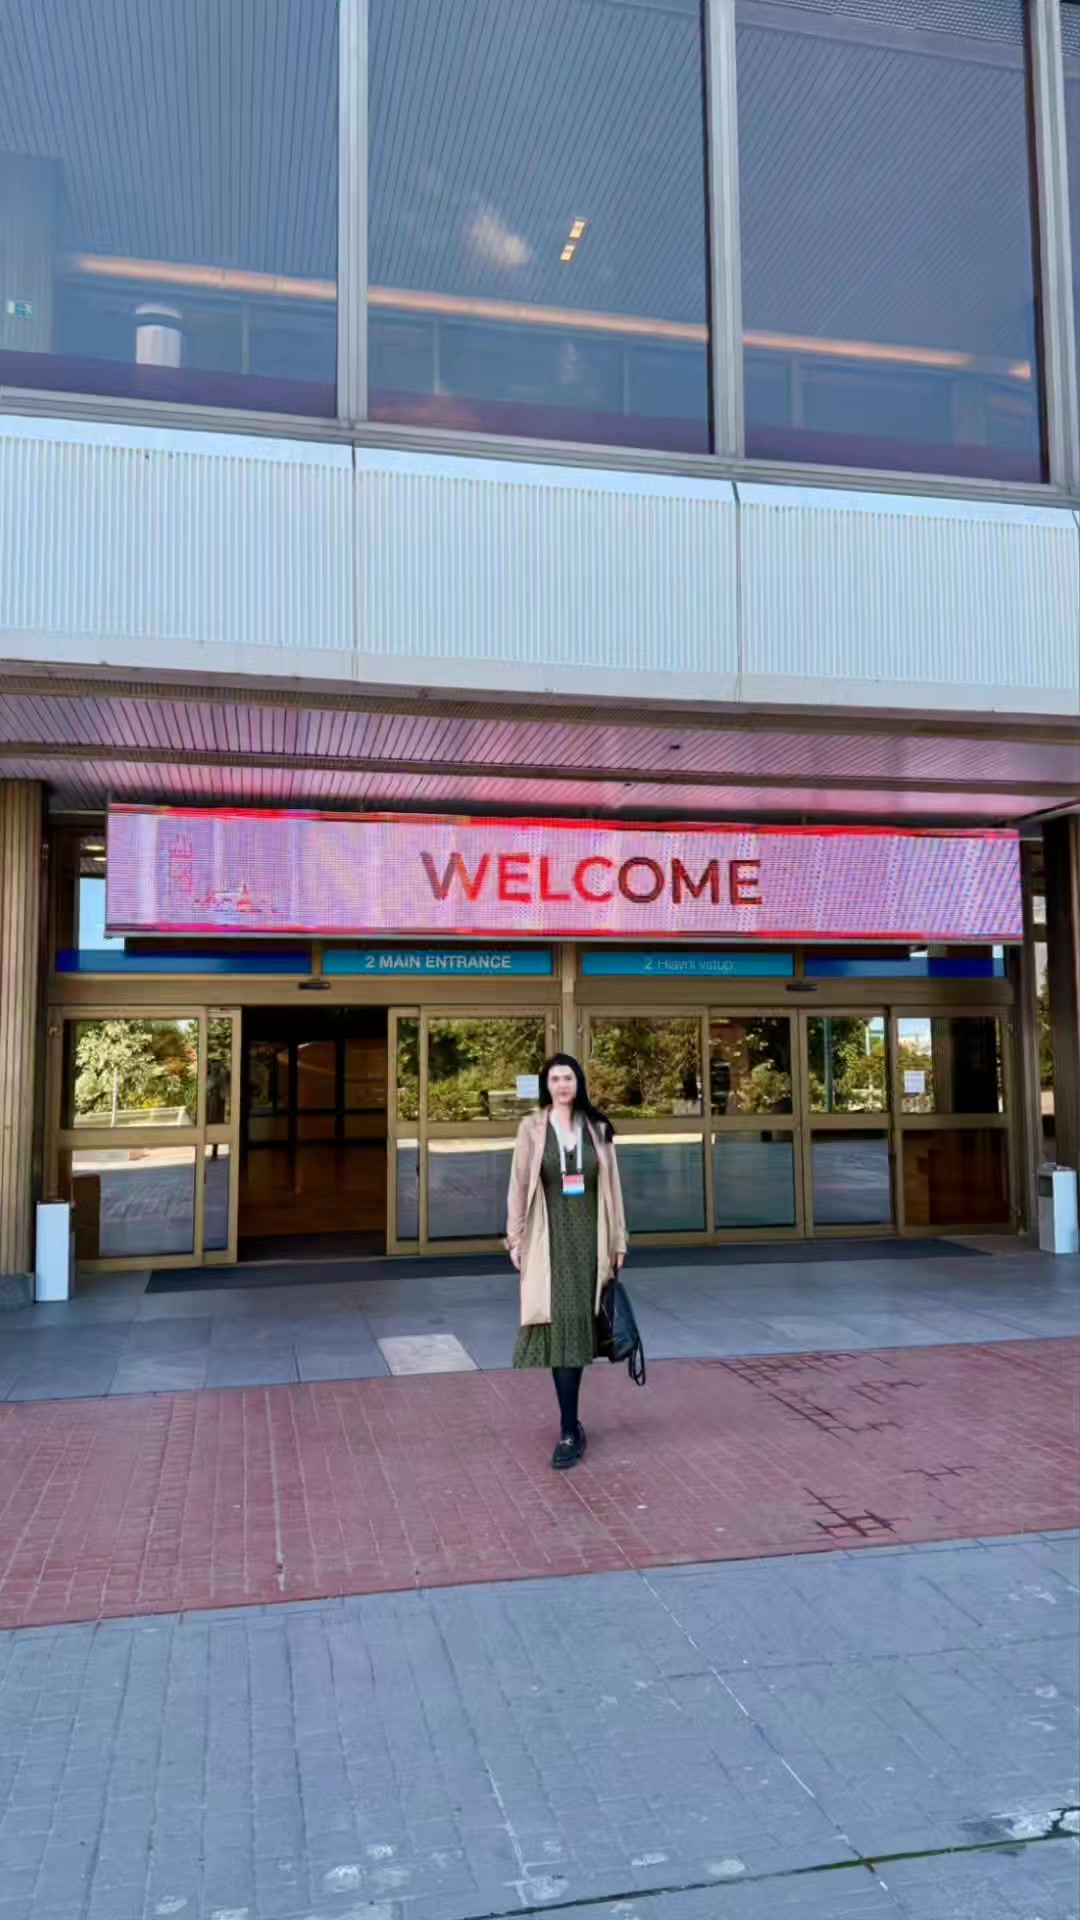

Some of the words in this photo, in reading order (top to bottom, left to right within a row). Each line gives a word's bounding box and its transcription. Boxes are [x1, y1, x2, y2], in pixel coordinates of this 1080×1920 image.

[420, 851, 763, 905] WELCOME
[365, 955, 375, 969] 2
[379, 955, 420, 969] MAIN
[425, 955, 511, 969] ENTRANCE
[643, 956, 653, 970] 2
